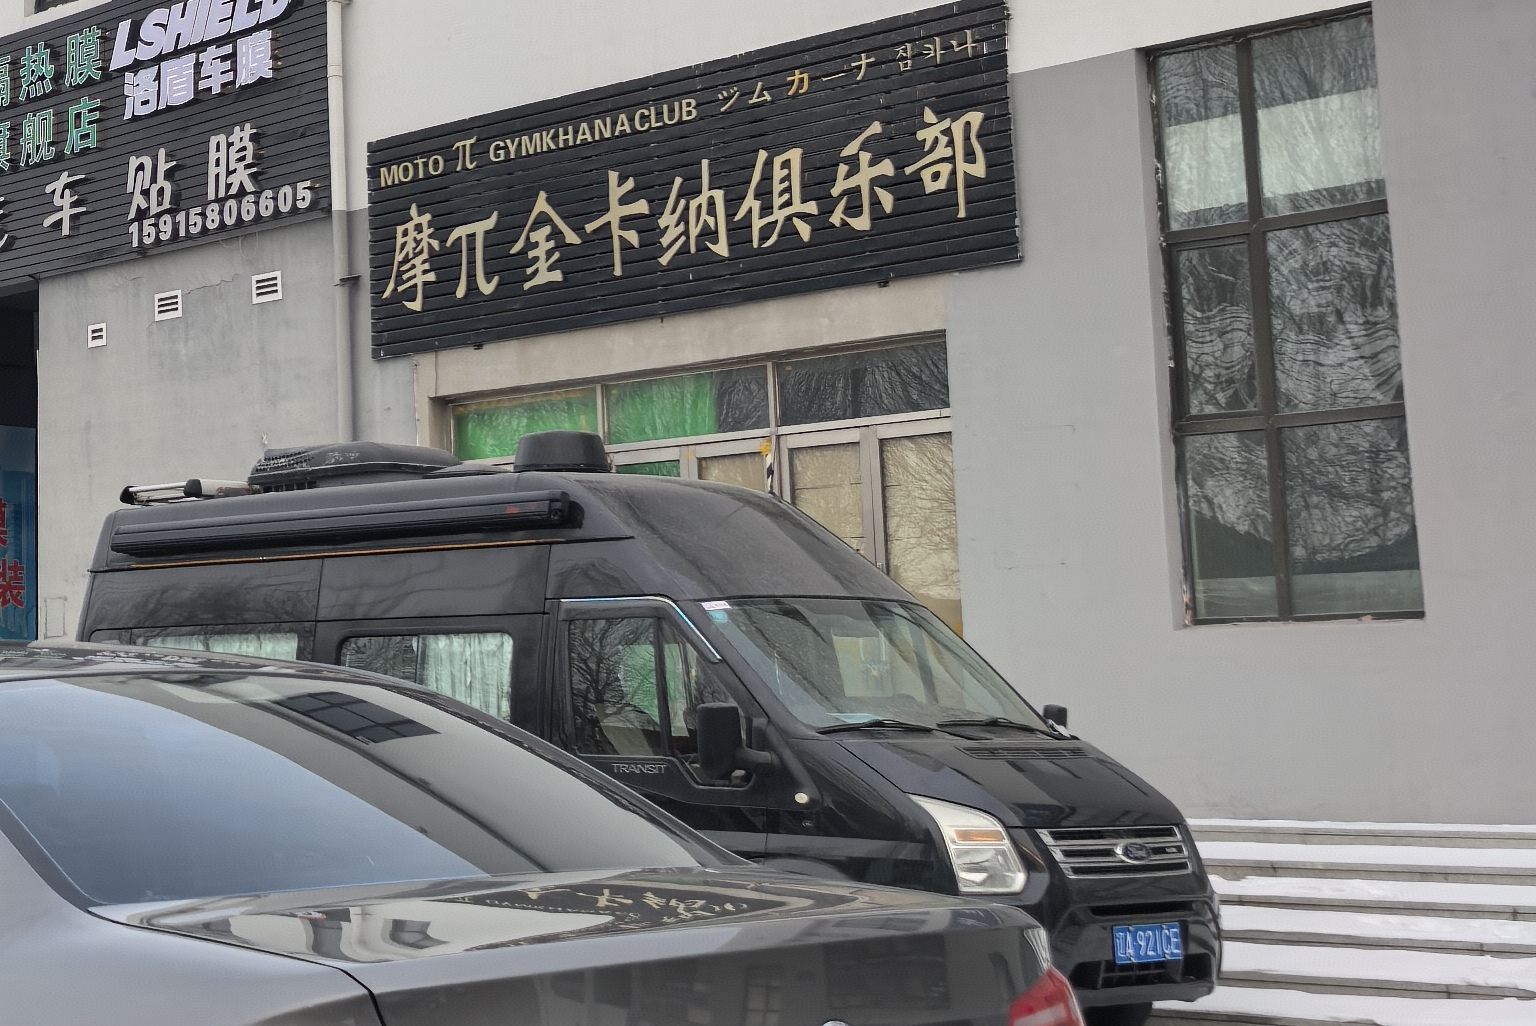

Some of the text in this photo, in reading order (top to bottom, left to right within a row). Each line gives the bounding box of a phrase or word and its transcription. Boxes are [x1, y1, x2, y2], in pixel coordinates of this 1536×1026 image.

[123, 29, 273, 120] 洛盾车膜
[379, 154, 445, 188] MOTO
[128, 179, 311, 248] 15915806605
[611, 763, 668, 774] TRANSIT
